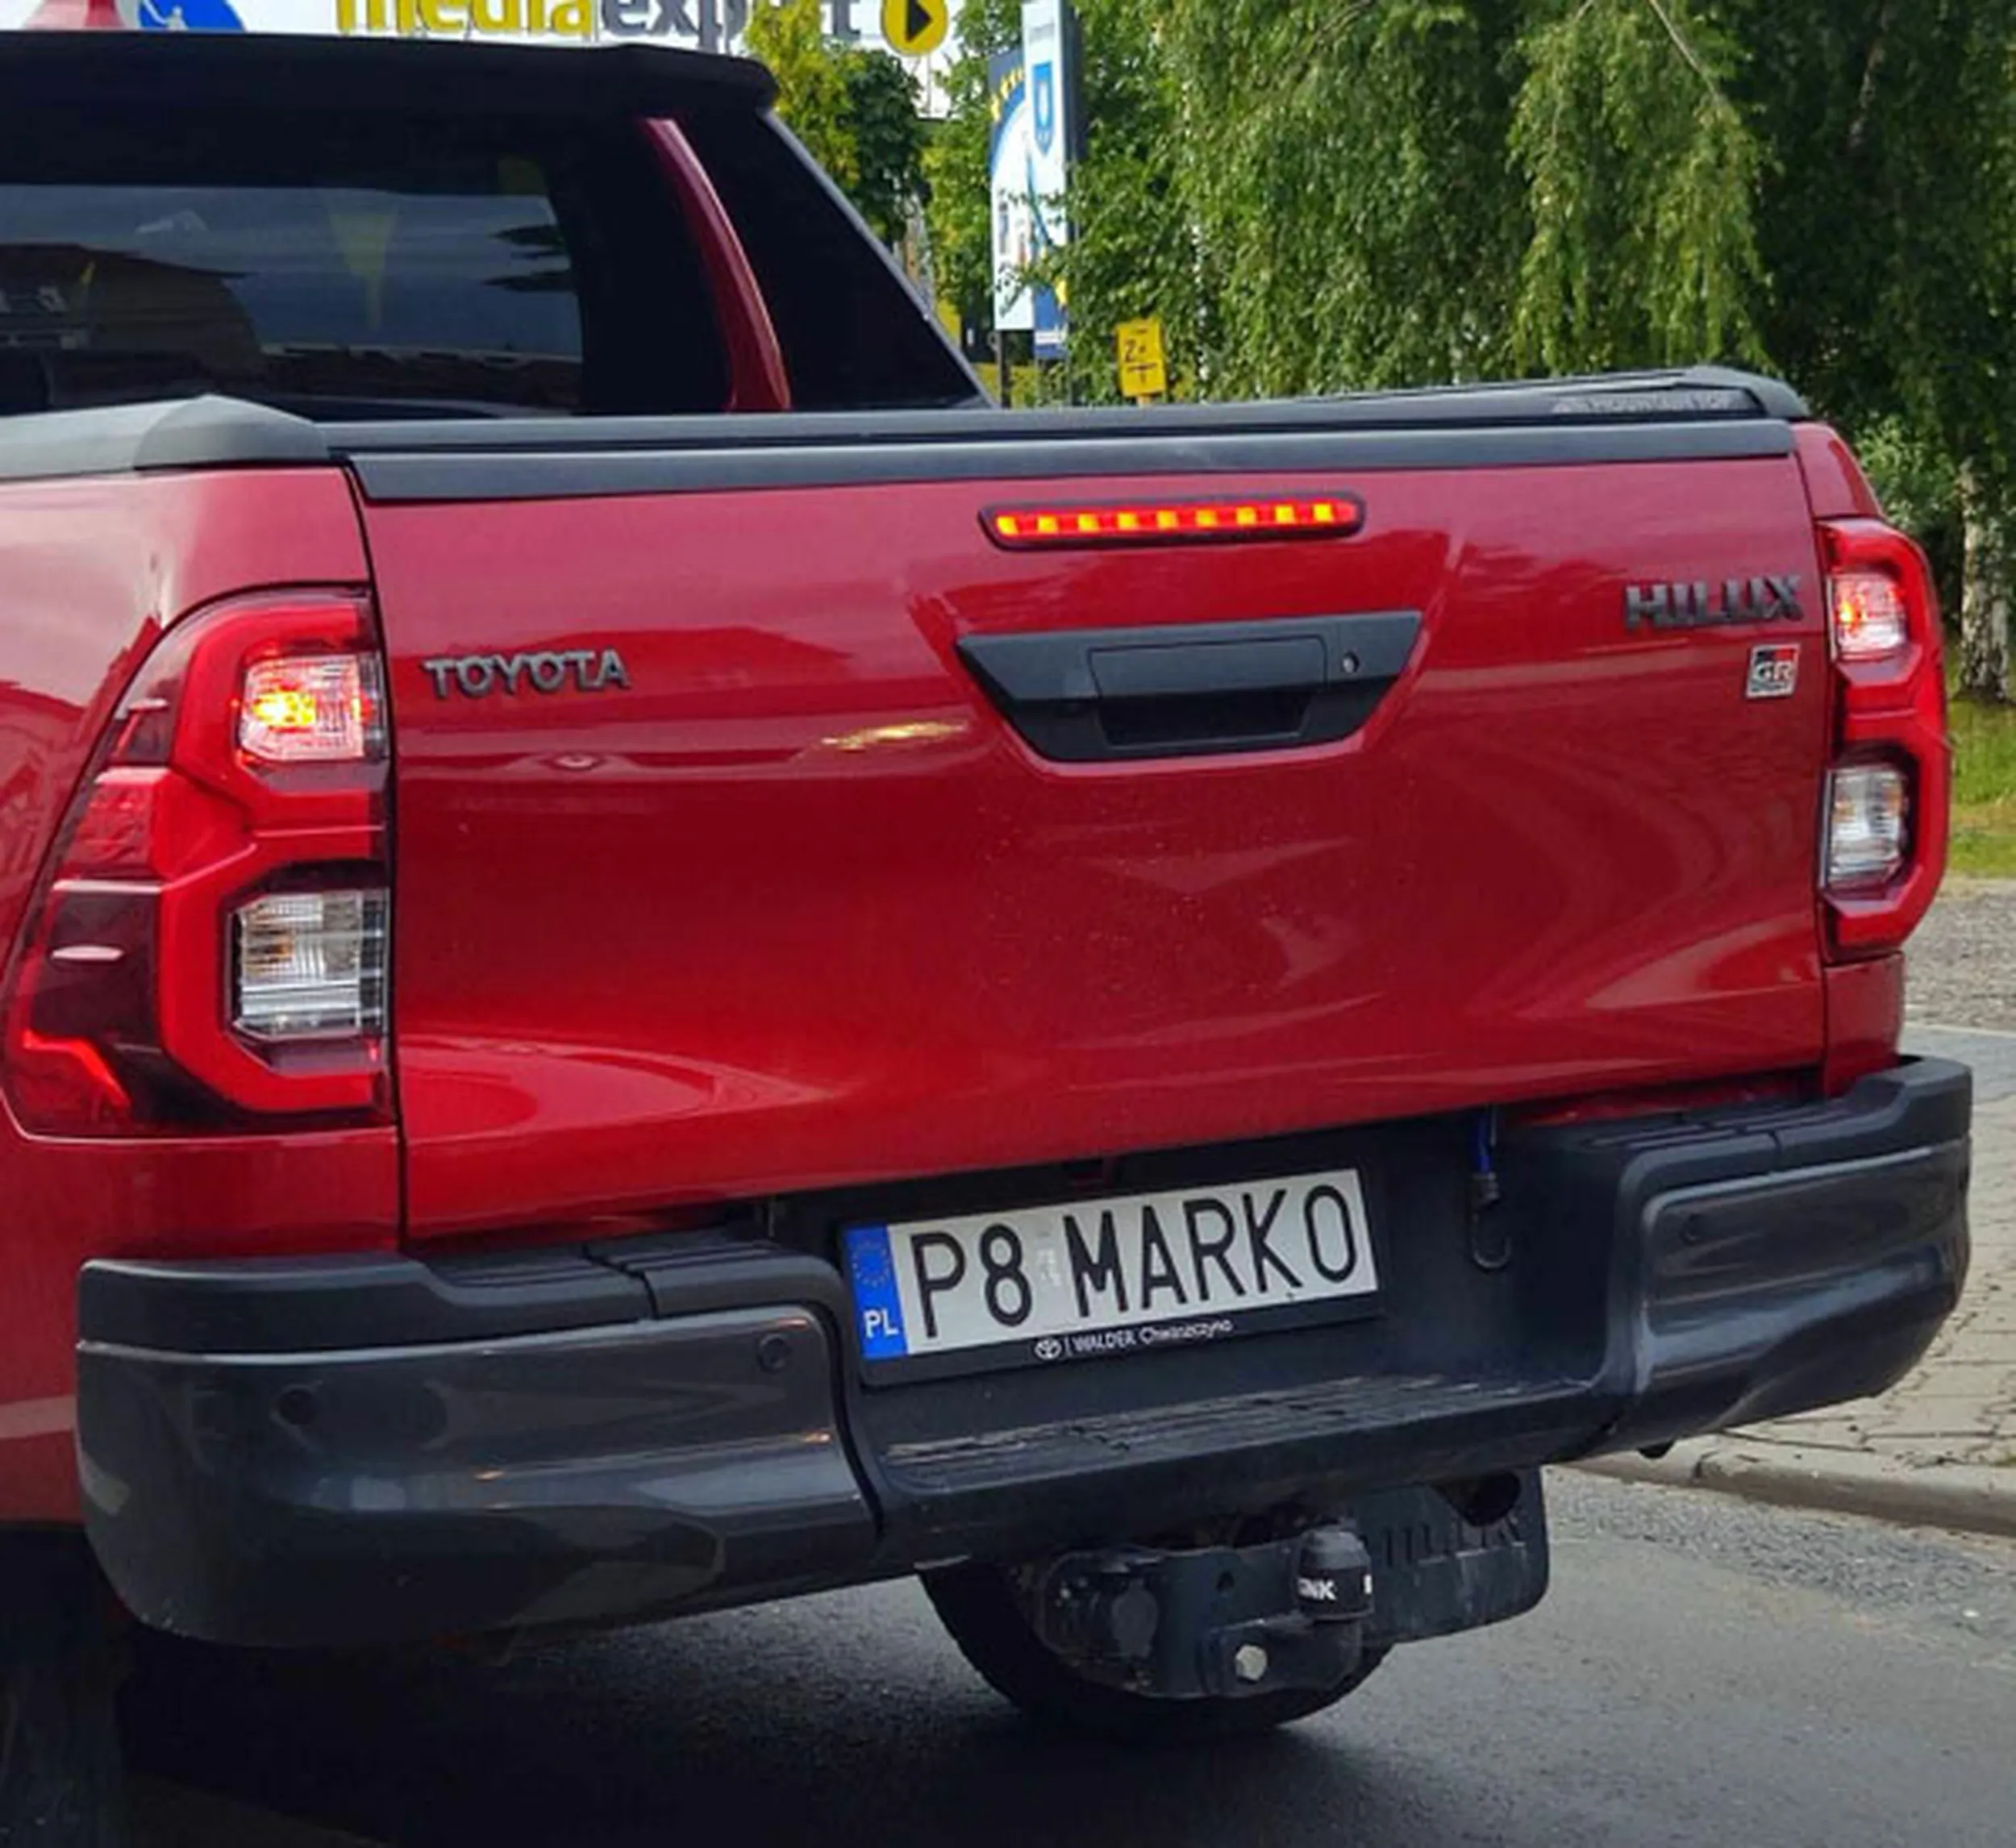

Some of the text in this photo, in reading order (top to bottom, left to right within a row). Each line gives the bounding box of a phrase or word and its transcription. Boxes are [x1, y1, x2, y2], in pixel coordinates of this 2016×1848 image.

[335, 0, 863, 55] mediaexpt
[1625, 575, 1804, 629] HILUX
[423, 648, 631, 699] TOYOTA
[909, 1184, 1359, 1338] P8 MARKO
[864, 1309, 898, 1338] PL
